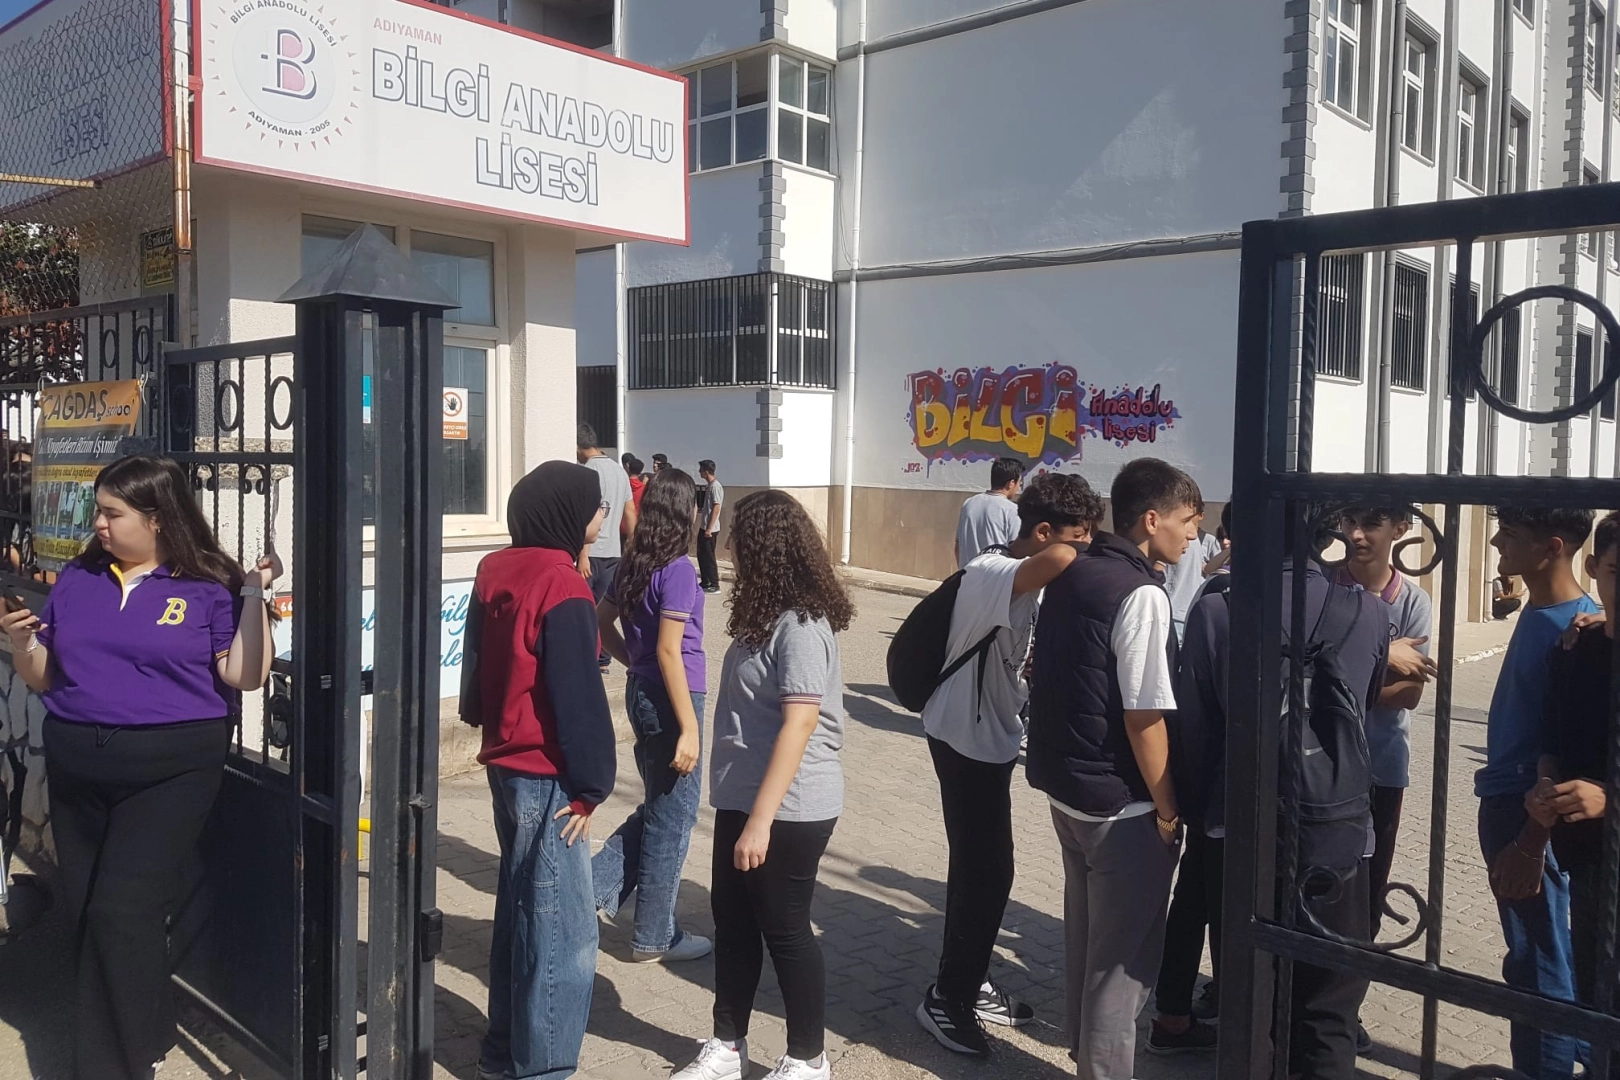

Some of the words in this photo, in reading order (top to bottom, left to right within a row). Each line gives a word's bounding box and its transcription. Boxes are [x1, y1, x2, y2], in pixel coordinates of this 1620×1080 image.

[373, 17, 442, 45] ADIYAMAN
[248, 110, 302, 136] ADIYAMAN
[309, 119, 331, 134] 2005
[372, 45, 490, 123] BİLGİ
[501, 83, 674, 163] ANADOLU
[475, 132, 598, 206] LİSESİ
